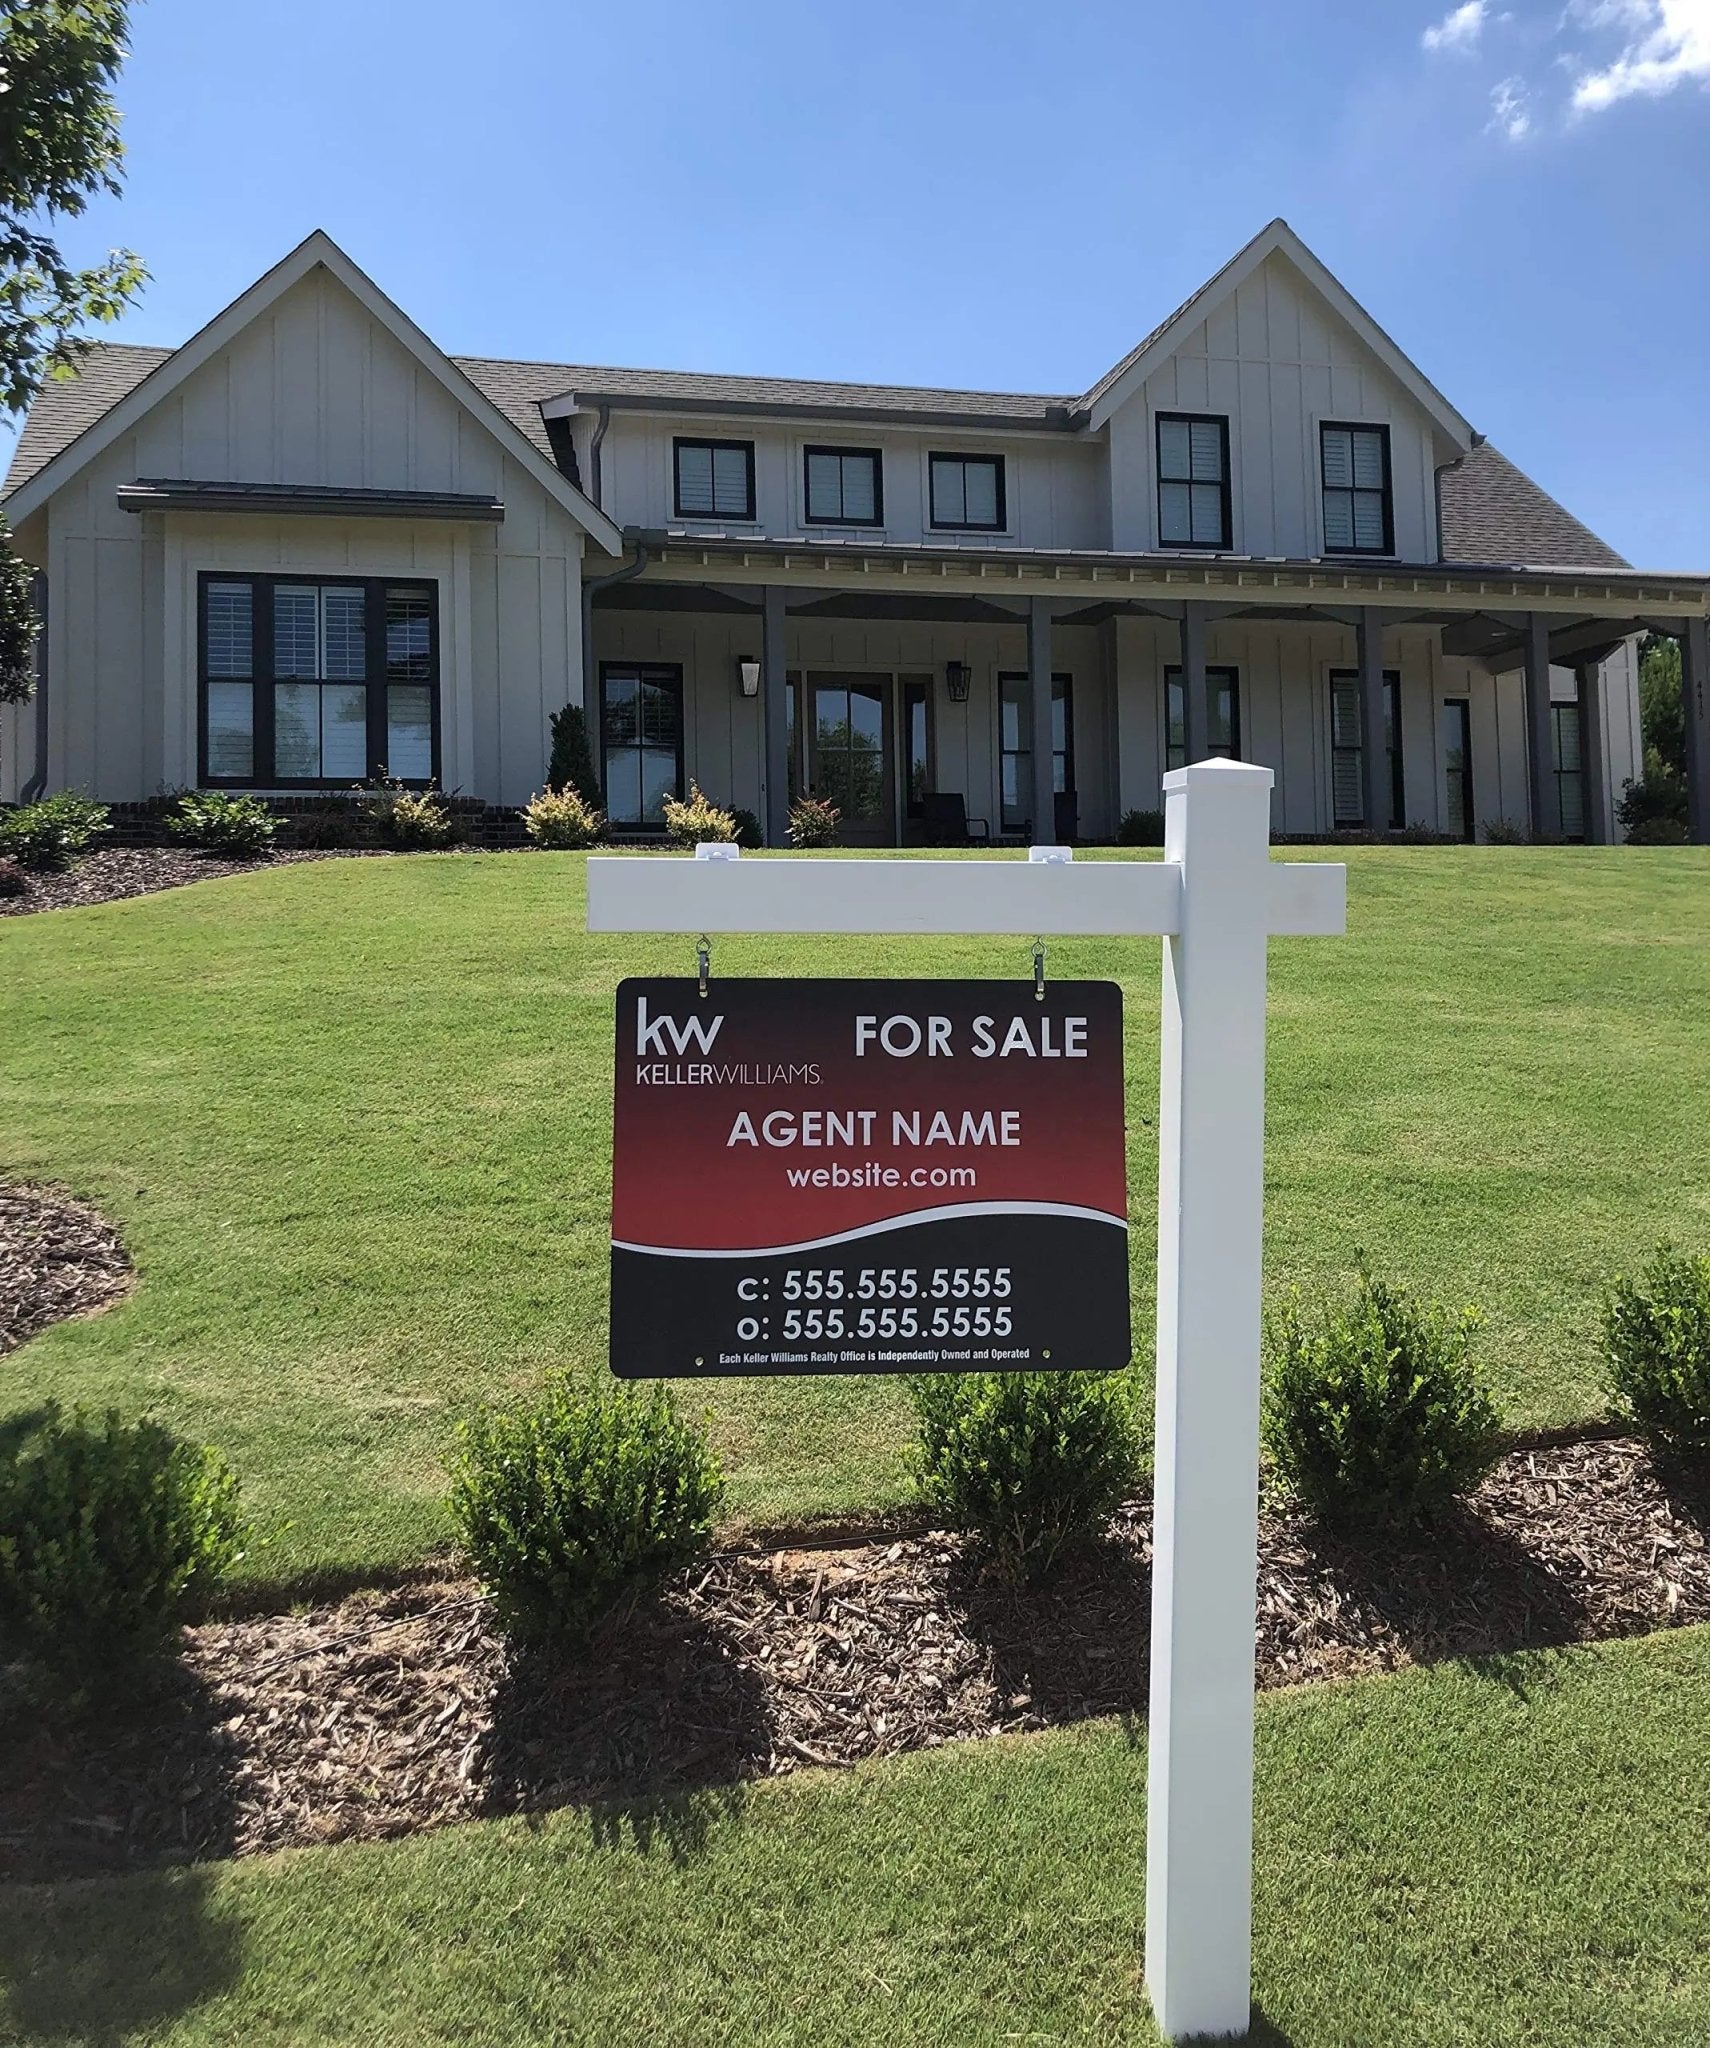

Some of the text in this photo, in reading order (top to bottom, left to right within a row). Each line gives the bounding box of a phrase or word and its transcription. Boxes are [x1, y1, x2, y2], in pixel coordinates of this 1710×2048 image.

[636, 996, 725, 1056] kw
[855, 1015, 1088, 1058] FOR SALE
[726, 1110, 1021, 1147] AGENT NAME
[786, 1161, 976, 1188] website.com
[736, 1267, 1012, 1301] c: 555.555.5555
[736, 1306, 1013, 1341] o: 555.555.5555
[719, 1347, 1030, 1364] Each Keller Williams Realty Office is Independently Owned and Operated
